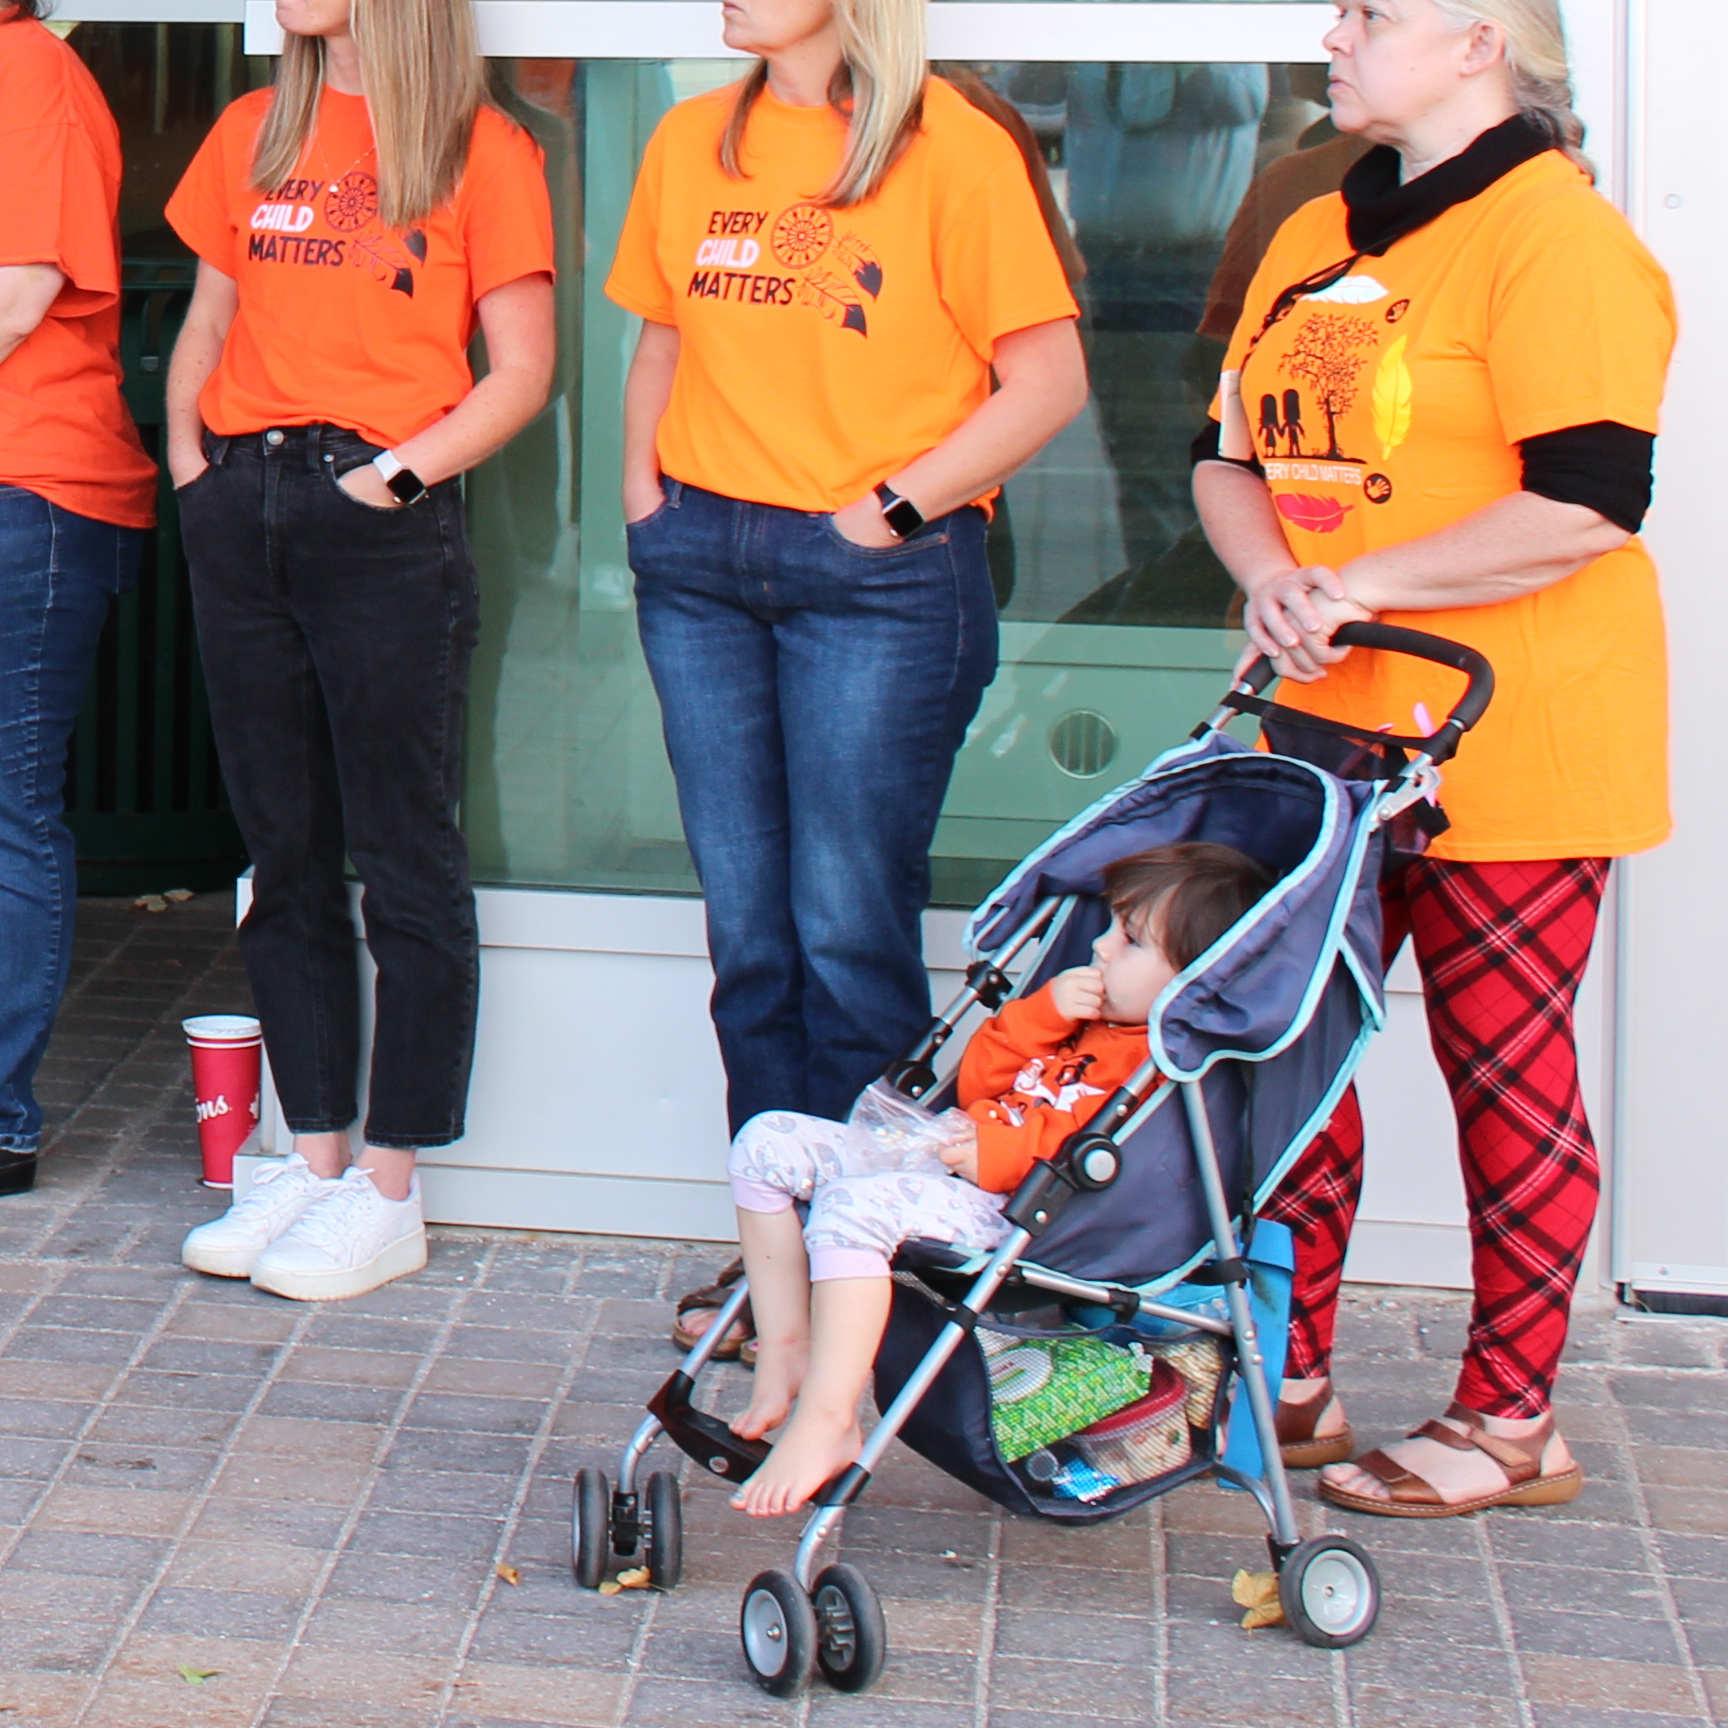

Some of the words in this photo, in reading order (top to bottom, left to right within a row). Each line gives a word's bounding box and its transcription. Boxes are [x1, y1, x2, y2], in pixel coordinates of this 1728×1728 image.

[250, 203, 314, 232] CHILD
[707, 210, 769, 235] EVERY
[248, 233, 346, 267] MATTERS
[694, 238, 760, 269] CHILD
[687, 271, 796, 306] MATTERS
[1291, 463, 1319, 481] CHILD
